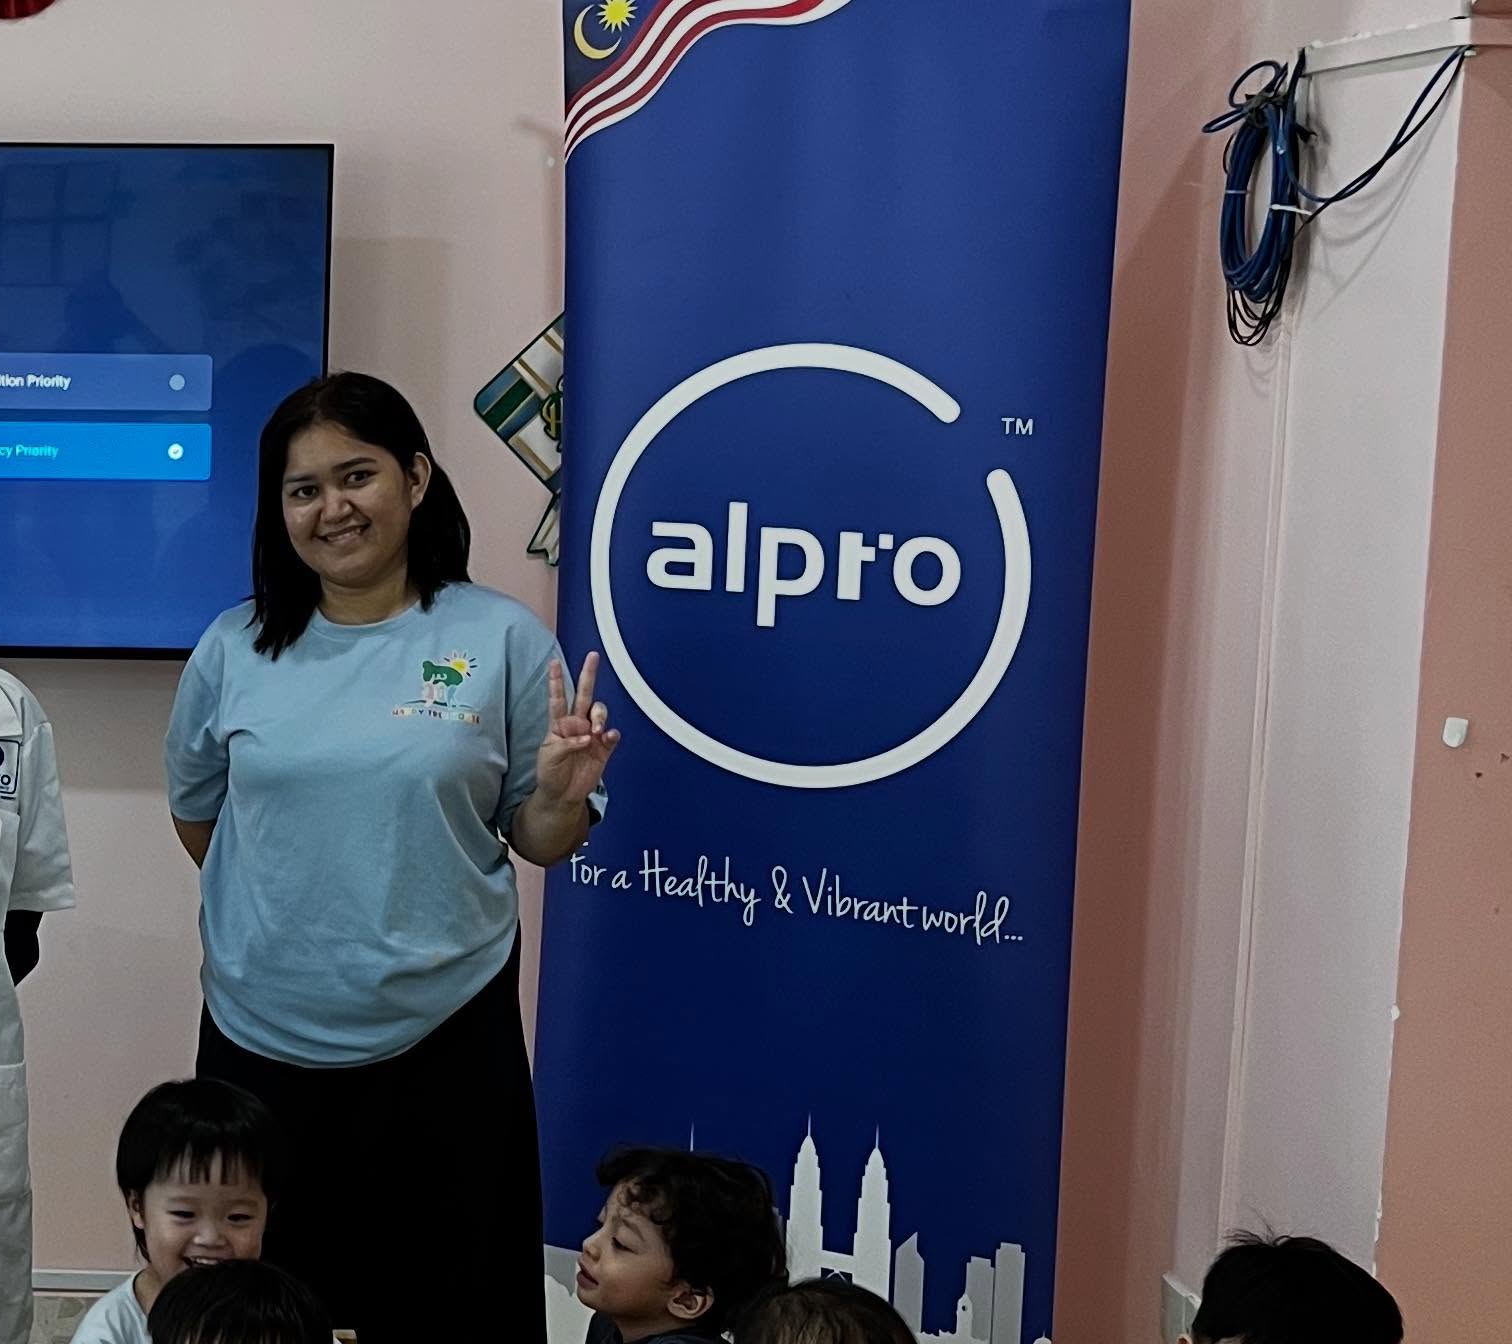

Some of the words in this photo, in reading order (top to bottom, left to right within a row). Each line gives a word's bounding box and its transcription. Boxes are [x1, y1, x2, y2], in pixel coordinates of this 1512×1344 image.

[27, 374, 72, 391] Priority
[1001, 417, 1034, 436] TM
[15, 444, 59, 459] Priority
[646, 501, 962, 628] alpro
[611, 870, 632, 889] a
[638, 849, 761, 926] Healthy
[771, 865, 794, 914] &
